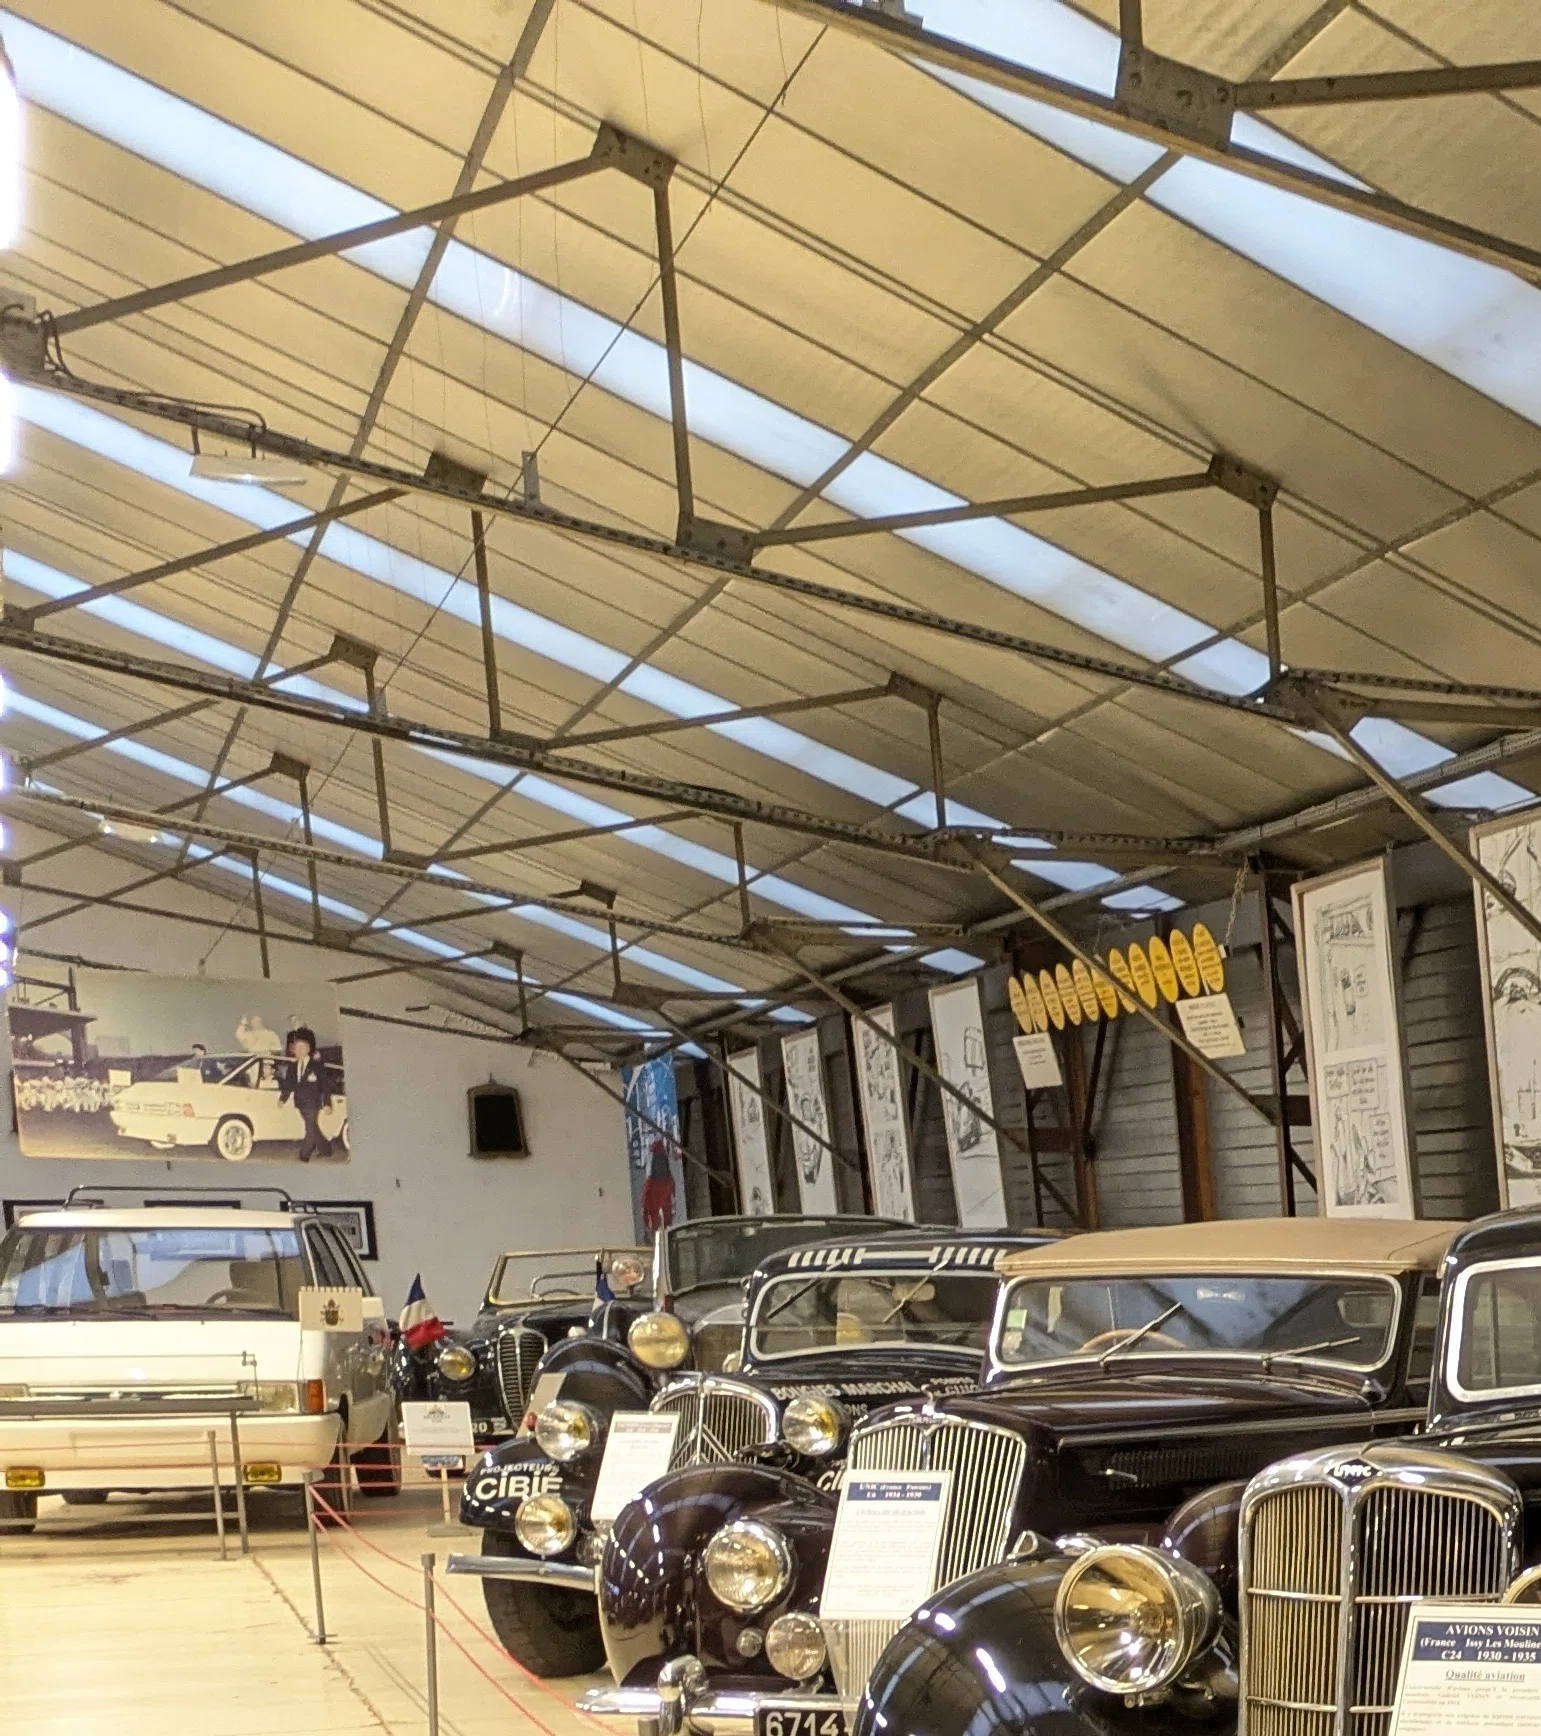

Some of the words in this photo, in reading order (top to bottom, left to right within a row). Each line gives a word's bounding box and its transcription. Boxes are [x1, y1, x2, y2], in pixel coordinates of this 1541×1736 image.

[1446, 1624, 1494, 1636] AVIONS
[1497, 1626, 1540, 1637] VOISIN
[1420, 1637, 1456, 1648] (France
[1486, 1639, 1502, 1649] Les
[1441, 1651, 1462, 1660] C24
[1477, 1651, 1502, 1661] 1930
[1512, 1652, 1537, 1662] 1935
[1446, 1670, 1483, 1681] Qualité
[1485, 1671, 1525, 1682] aviation
